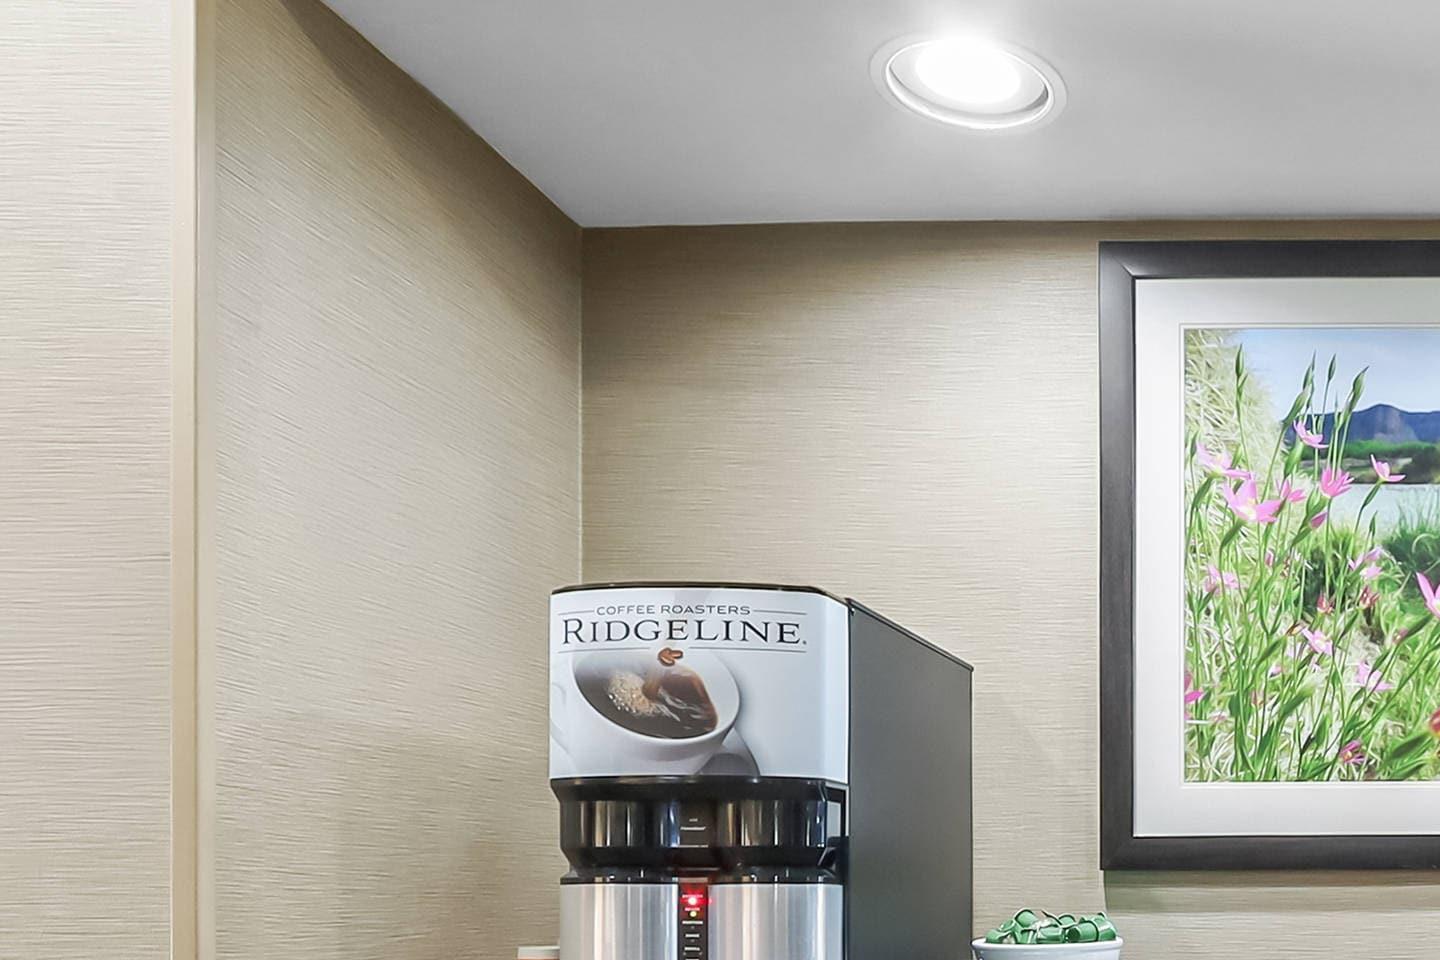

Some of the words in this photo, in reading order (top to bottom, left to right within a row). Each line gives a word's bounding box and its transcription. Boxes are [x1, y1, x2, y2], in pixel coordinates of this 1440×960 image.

[596, 605, 656, 616] COFFEE
[660, 604, 751, 615] ROASTERS
[562, 618, 802, 645] RIDGELINE
